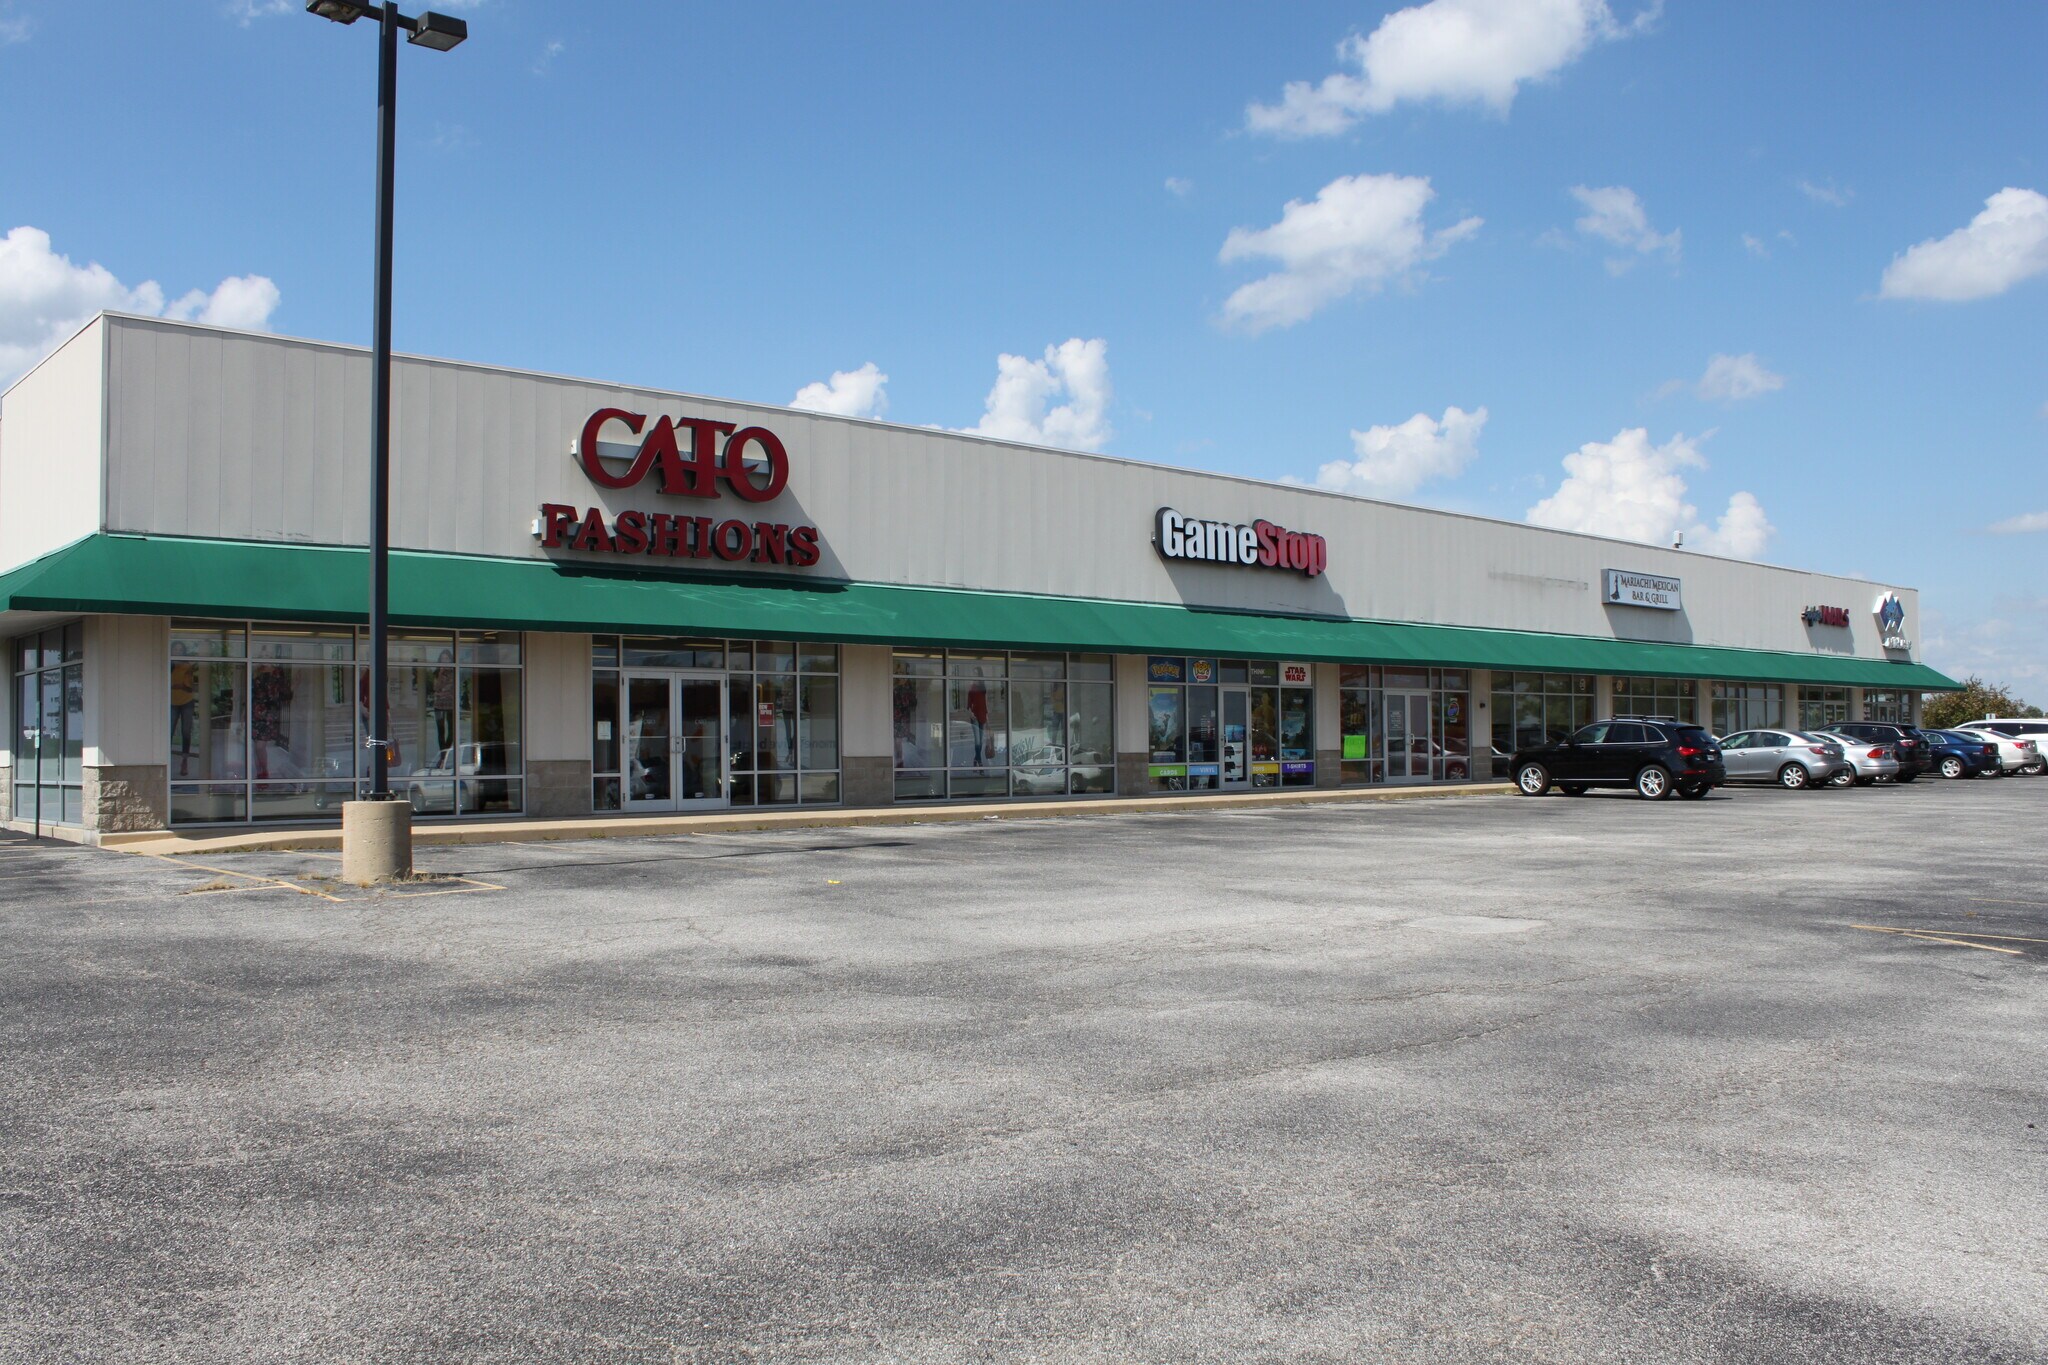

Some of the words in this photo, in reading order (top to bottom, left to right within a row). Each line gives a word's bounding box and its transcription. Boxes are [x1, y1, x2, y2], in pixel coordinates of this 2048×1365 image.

[579, 407, 790, 503] CATO
[540, 503, 821, 567] FASHIONS
[1156, 506, 1328, 577] GameStop
[1619, 574, 1651, 589] MARIACHI
[1651, 578, 1679, 593] MEXICAN
[1632, 590, 1645, 602] BAR
[1645, 592, 1652, 604] &
[1652, 592, 1669, 605] GRILL
[1285, 666, 1306, 674] STAR
[1285, 674, 1306, 682] WARS
